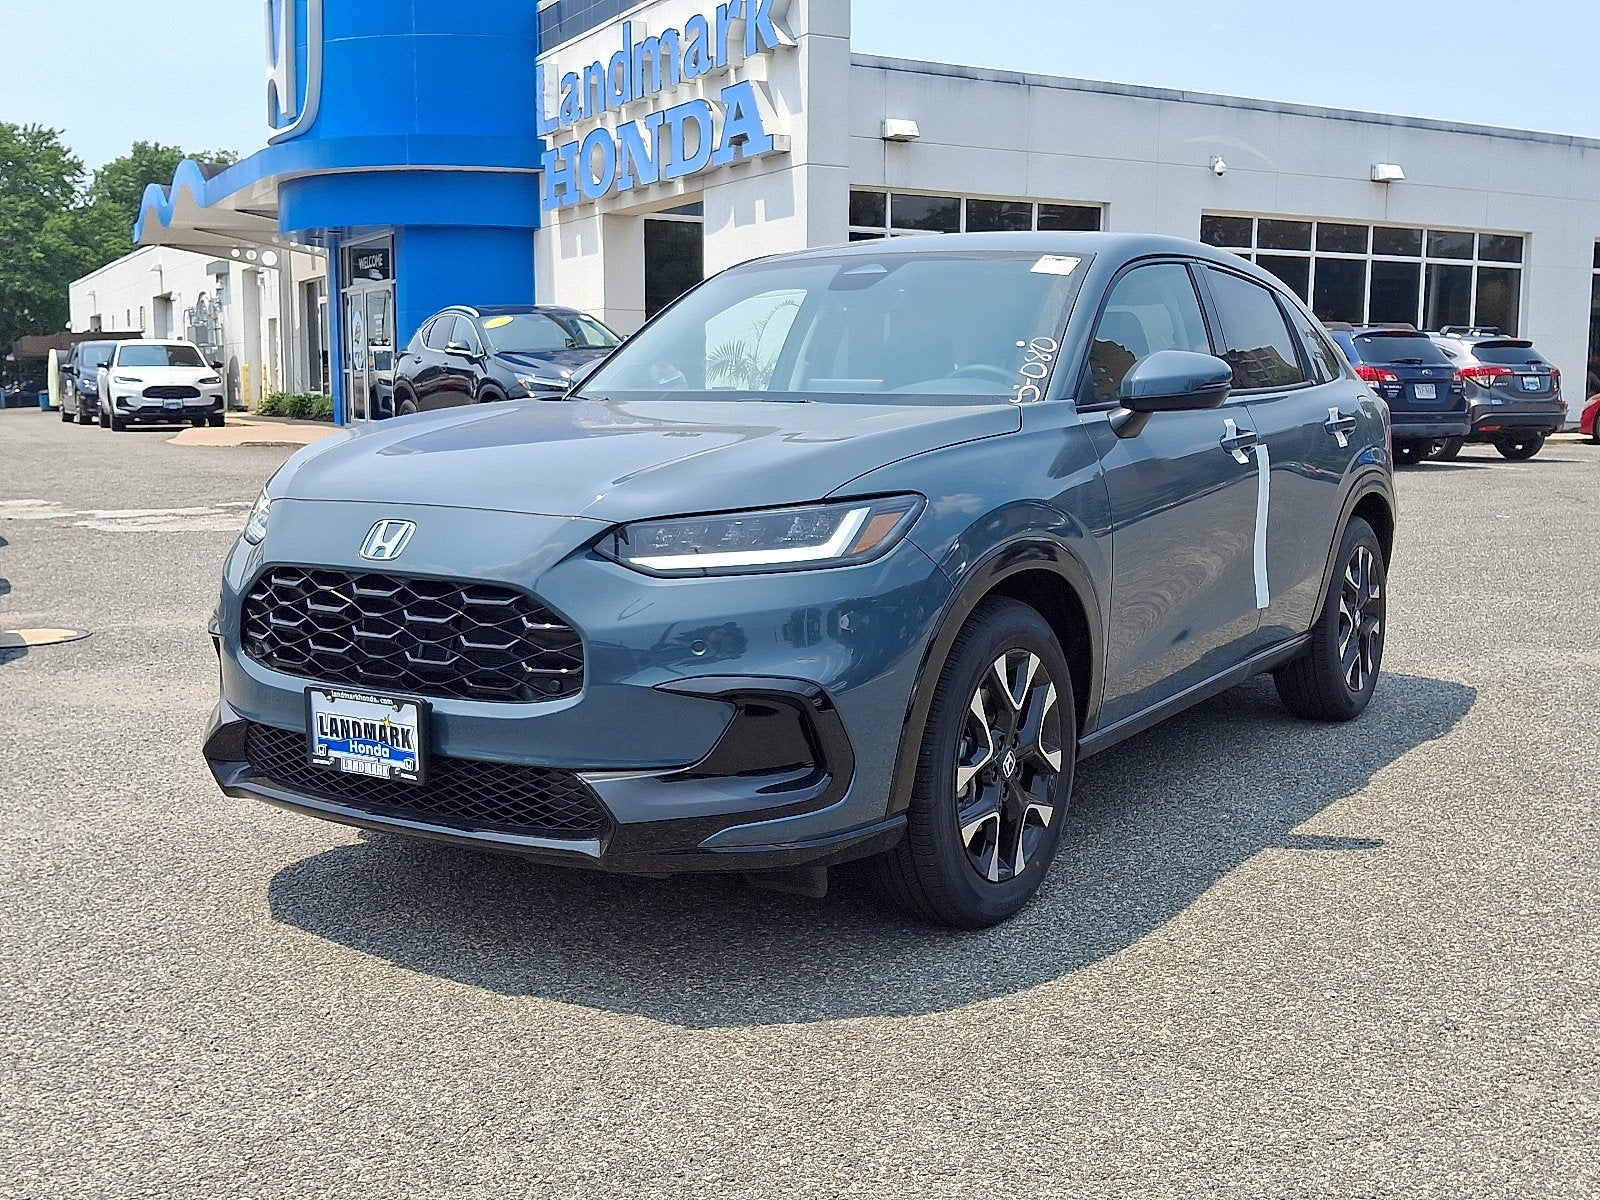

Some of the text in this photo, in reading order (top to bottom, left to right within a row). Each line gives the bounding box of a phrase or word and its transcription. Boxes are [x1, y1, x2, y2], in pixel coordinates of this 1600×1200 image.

[536, 0, 778, 136] Landmark
[541, 80, 773, 211] HONDA
[359, 253, 384, 270] WELCOME
[318, 715, 413, 750] LANDMARK
[349, 740, 390, 758] Honda
[341, 757, 390, 779] LANDMARK
